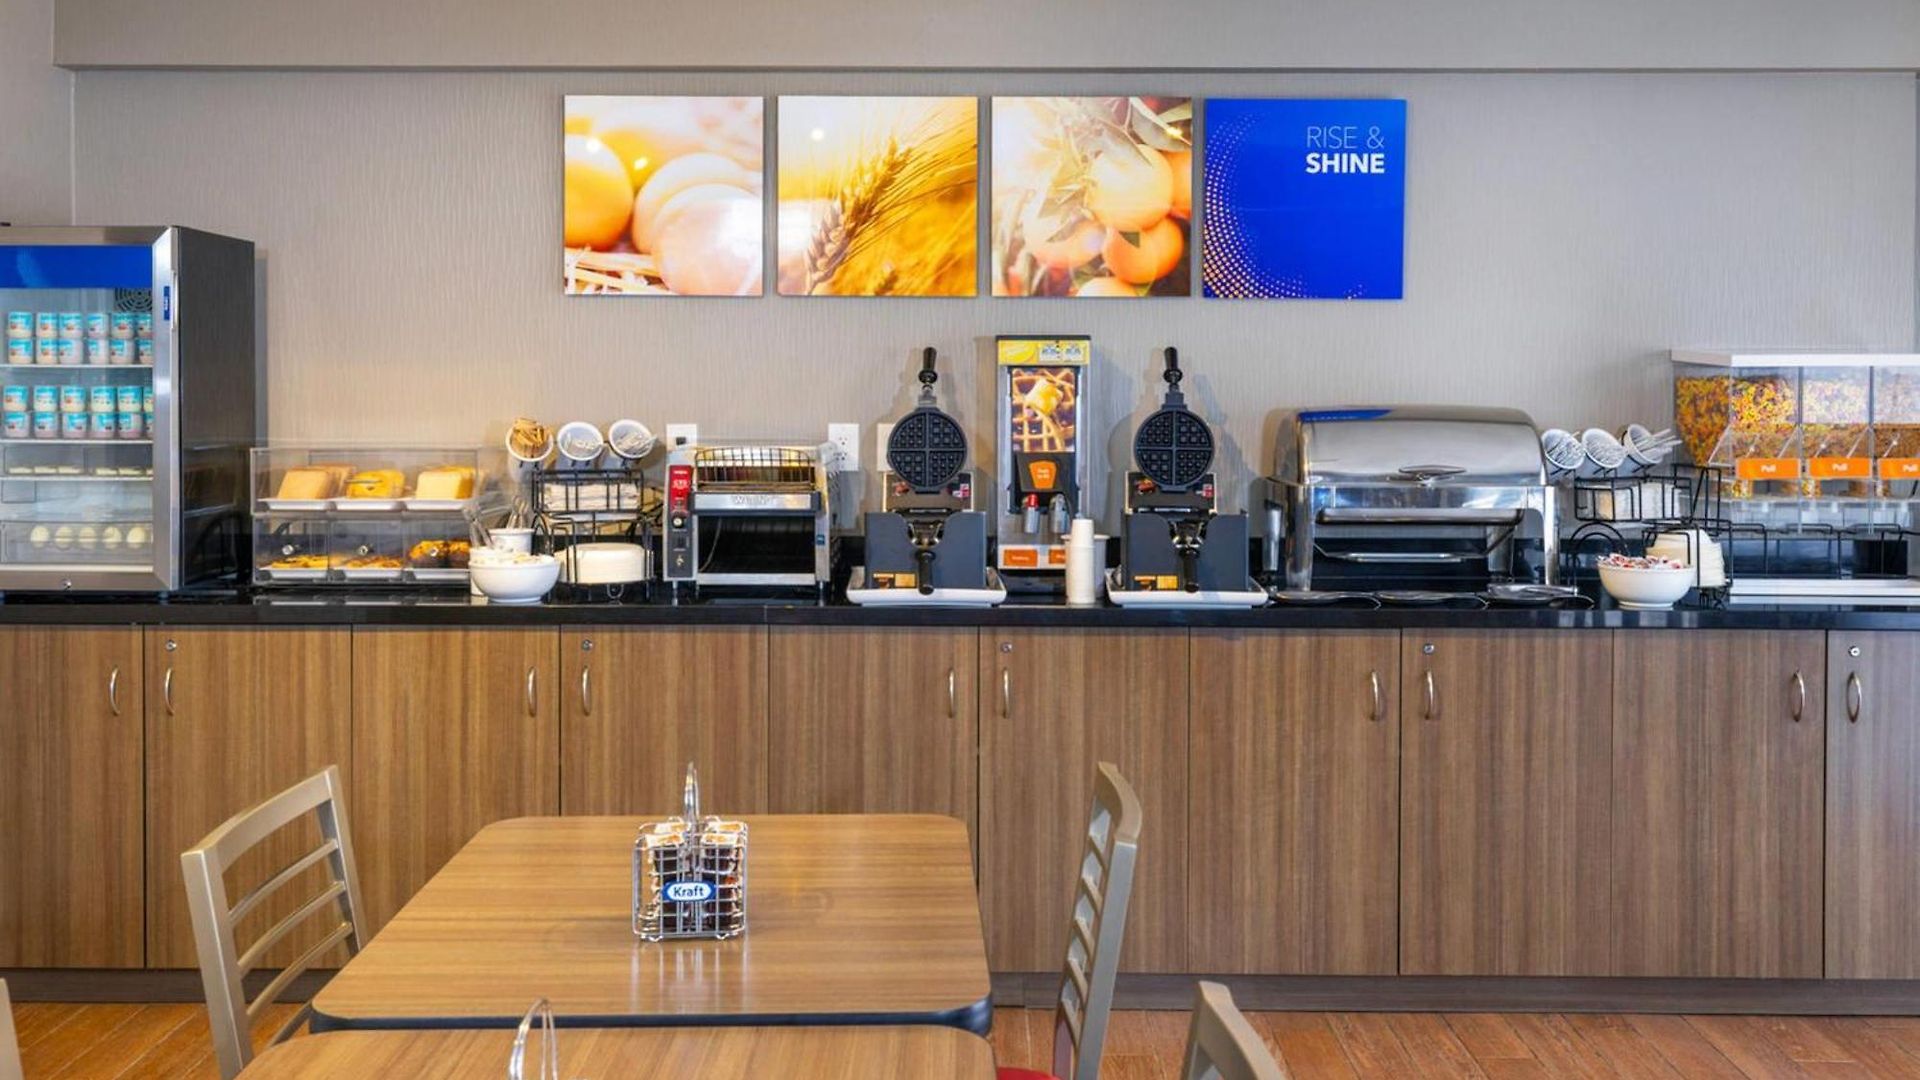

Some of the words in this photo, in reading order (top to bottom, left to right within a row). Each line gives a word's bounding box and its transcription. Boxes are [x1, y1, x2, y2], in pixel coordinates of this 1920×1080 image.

[1306, 125, 1358, 149] RISE
[1366, 125, 1384, 149] &
[1305, 152, 1385, 174] SHINE
[673, 885, 704, 897] Kraft
